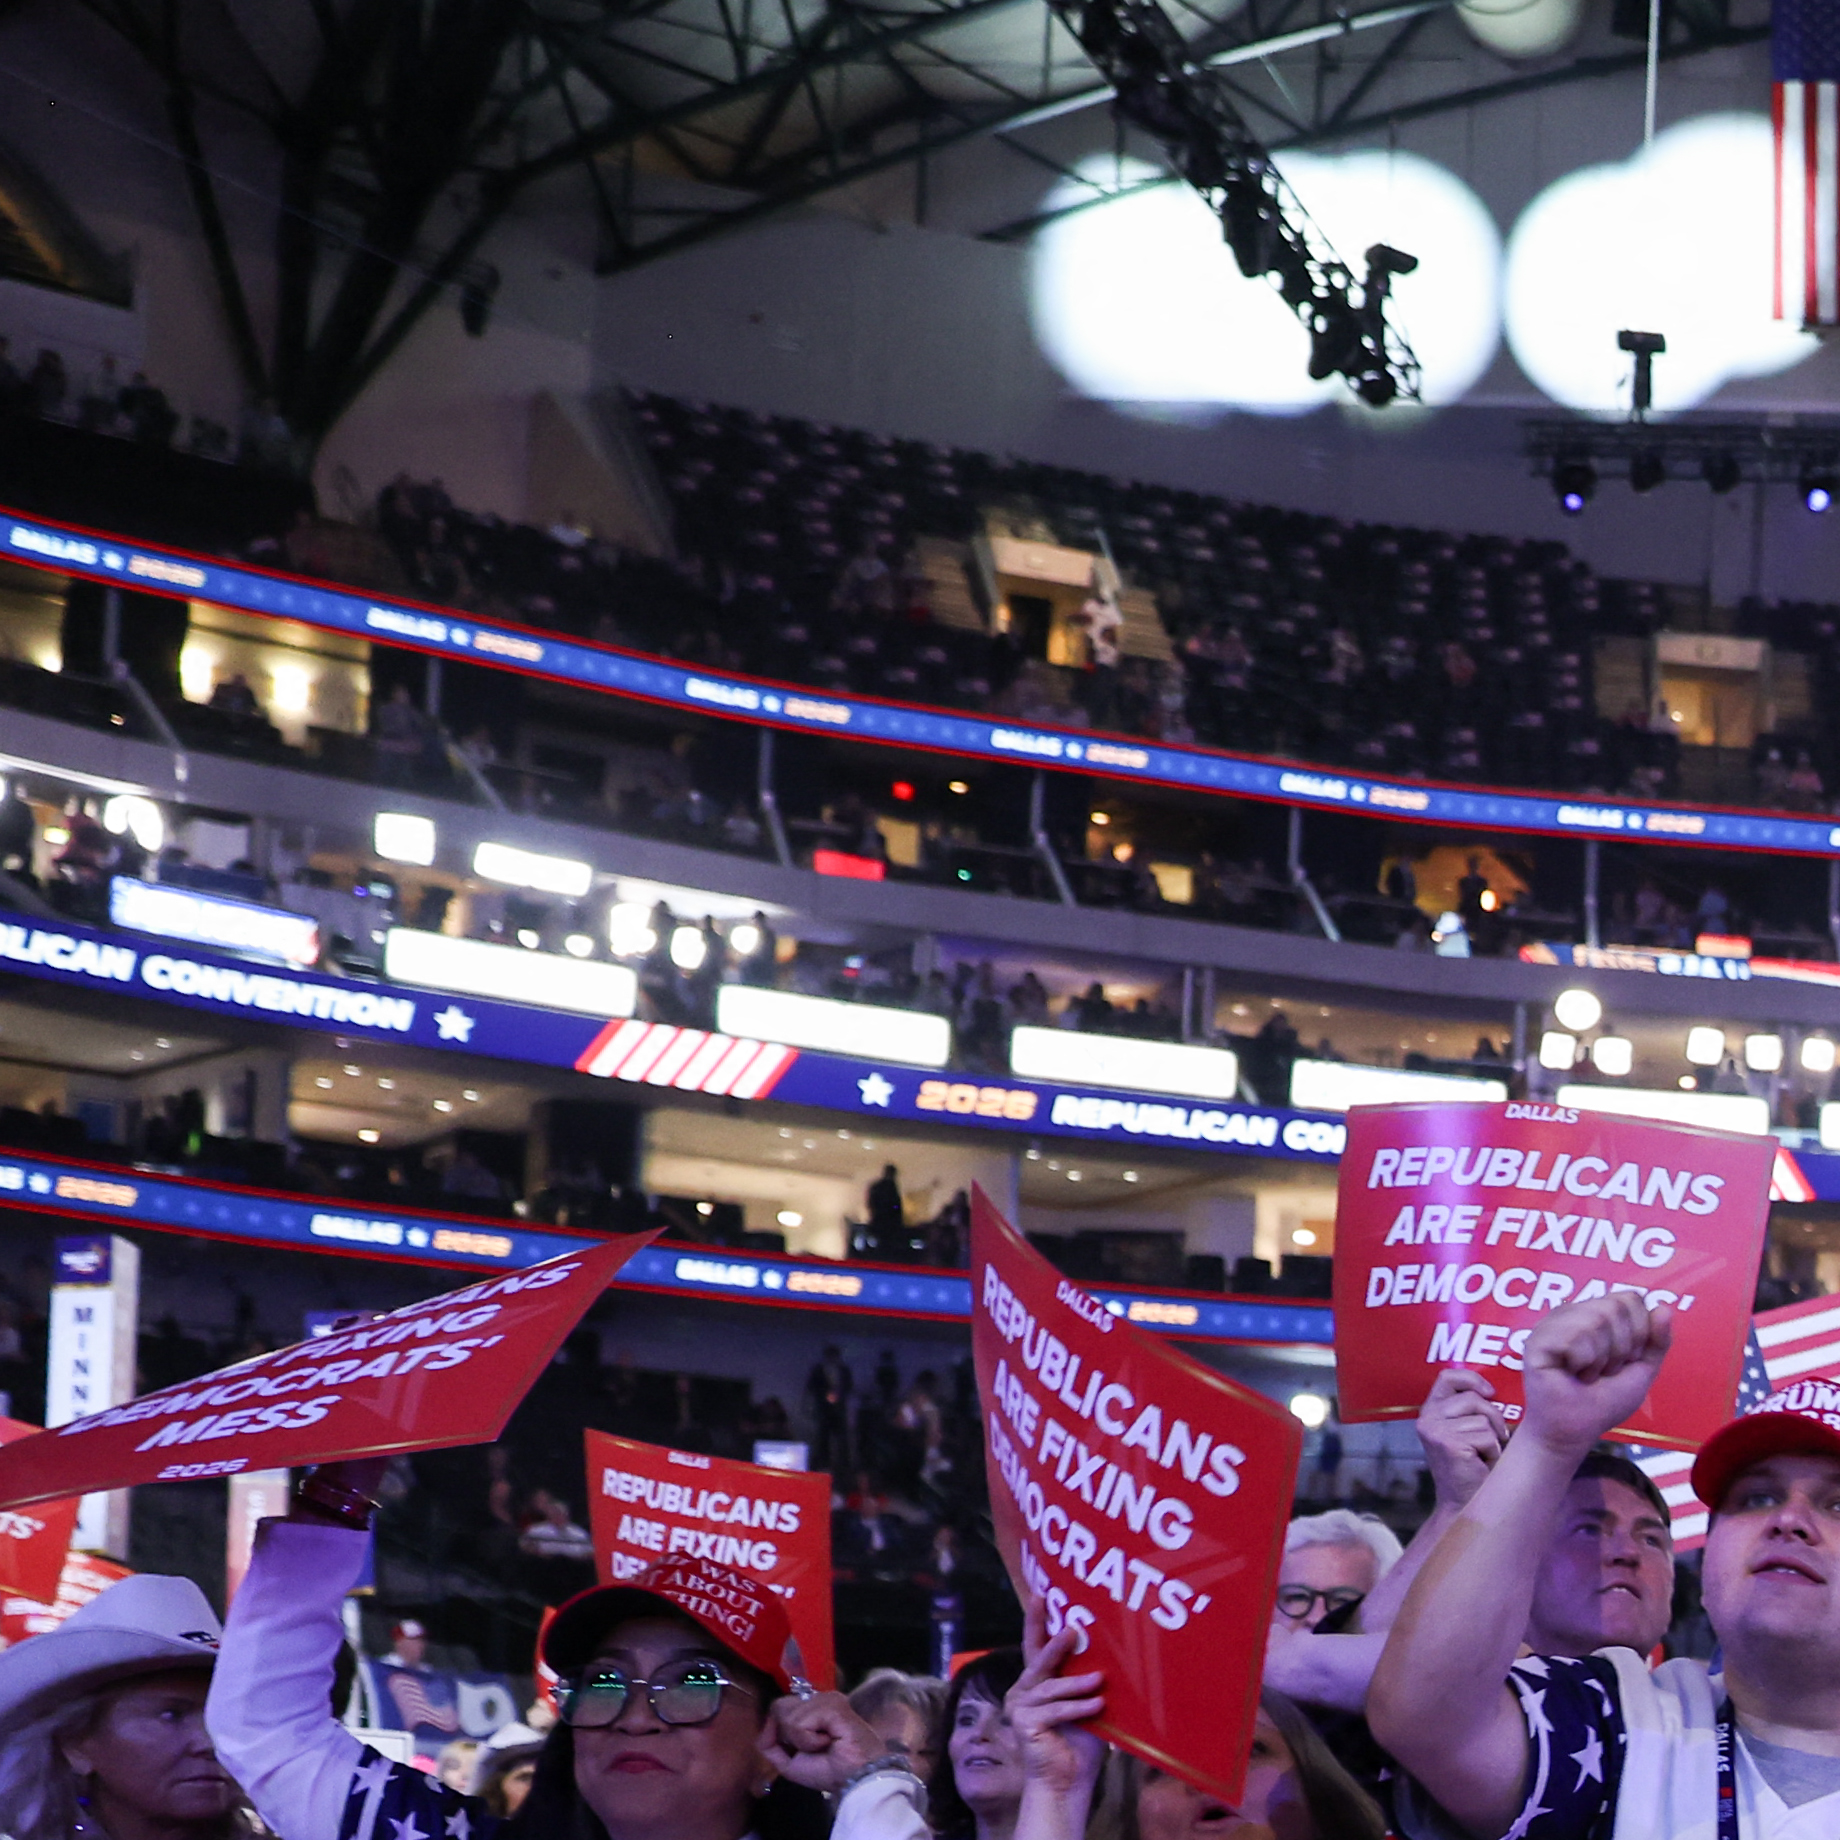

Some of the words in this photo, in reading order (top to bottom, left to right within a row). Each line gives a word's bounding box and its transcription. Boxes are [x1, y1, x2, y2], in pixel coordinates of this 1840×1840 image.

[10, 526, 98, 566] DALLAS
[366, 606, 448, 643] DALLAS
[990, 728, 1063, 759] DALLAS
[141, 955, 415, 1032] CONVENTION
[914, 1081, 1038, 1121] 2026
[1051, 1096, 1280, 1154] REPUBLICAN
[1505, 1103, 1580, 1124] DALLAS
[1368, 1146, 1725, 1215] REPUBLICANS
[309, 1214, 403, 1245] DALLAS
[1384, 1205, 1483, 1246] ARE
[1485, 1206, 1676, 1268] FIXING
[675, 1259, 761, 1289] DALLAS
[1055, 1279, 1115, 1333] DALLAS
[982, 1265, 1245, 1499] REPUBLICANS
[135, 1395, 342, 1452] MESS
[158, 1458, 249, 1479] 2026
[992, 1360, 1034, 1445] ARE
[1039, 1416, 1194, 1552] FIXING
[603, 1468, 801, 1533] REPUBLICANS
[988, 1413, 1212, 1632] DEMOCRATS'
[617, 1515, 667, 1551] ARE
[669, 1527, 778, 1571] FIXING
[663, 1569, 764, 1618] ABOUT
[702, 1561, 756, 1593] WAS
[1717, 1723, 1730, 1772] DALLAS
